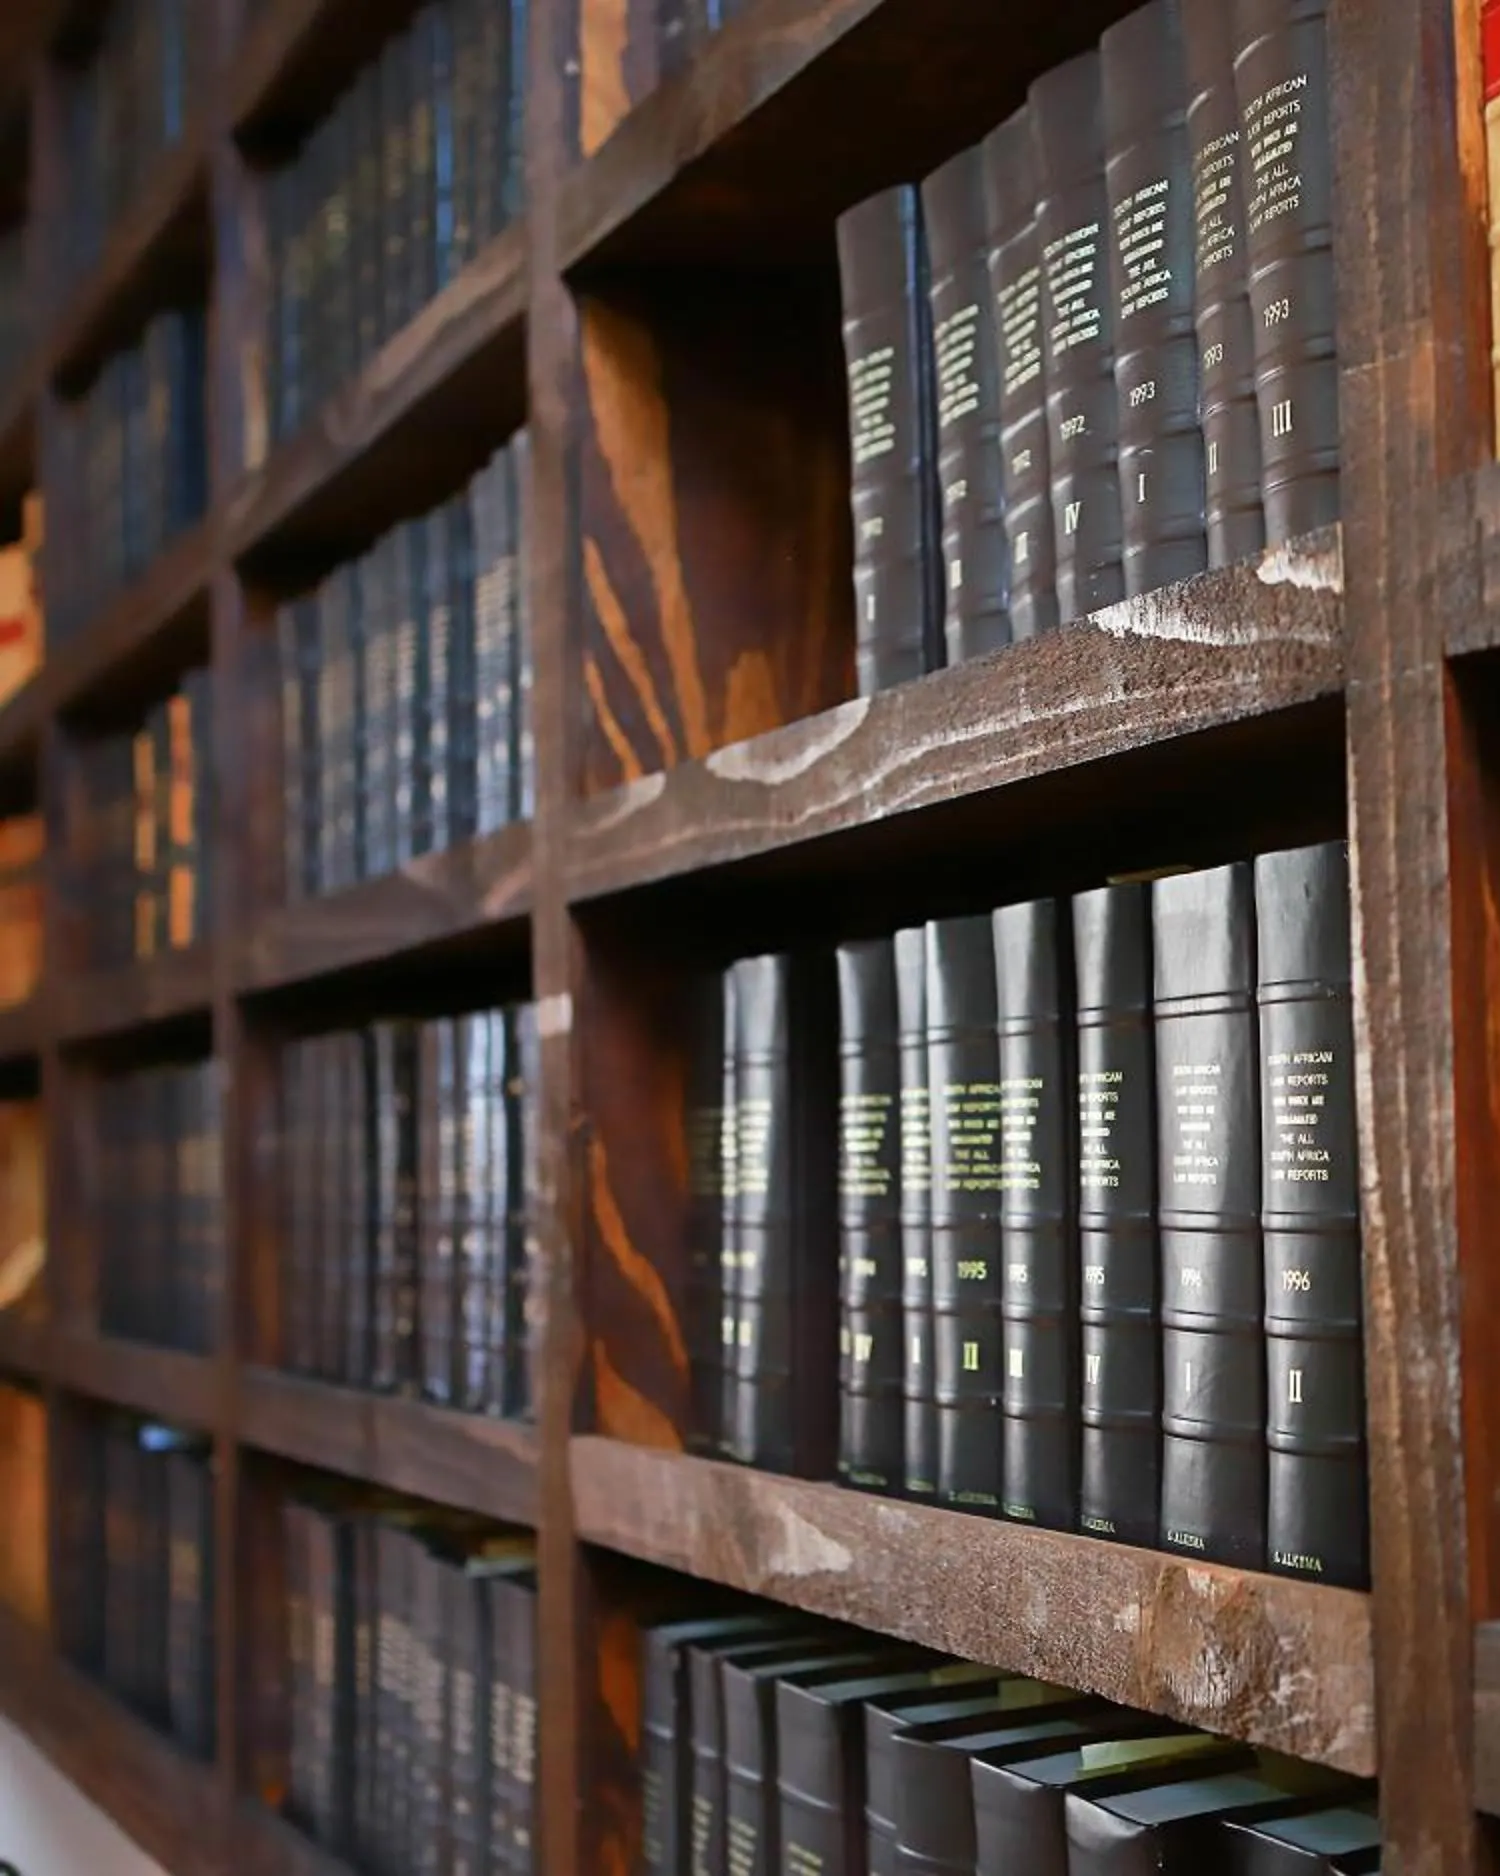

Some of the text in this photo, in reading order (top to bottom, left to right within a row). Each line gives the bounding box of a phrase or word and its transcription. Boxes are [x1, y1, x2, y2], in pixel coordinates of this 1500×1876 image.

[1265, 74, 1307, 104] AFRICAN
[1263, 99, 1301, 127] REPORTS
[1272, 163, 1288, 180] ALL
[1269, 175, 1301, 199] AFRICA
[1264, 194, 1299, 220] REPORTS
[1263, 298, 1290, 328] 1993
[1129, 381, 1156, 407] 1993
[1271, 399, 1293, 438] III
[1138, 473, 1146, 503] I
[1065, 501, 1081, 535] IV
[1293, 1051, 1333, 1064] AFRICAN
[1287, 1073, 1329, 1086] REPORTS
[1280, 1133, 1315, 1145] THE ALL
[1297, 1150, 1330, 1162] AFRICA
[1287, 1169, 1329, 1181] REPORTS
[957, 1261, 987, 1280] 1995
[1282, 1269, 1311, 1292] 1996
[963, 1342, 979, 1371] II
[1184, 1361, 1192, 1392] I
[1289, 1369, 1302, 1403] II
